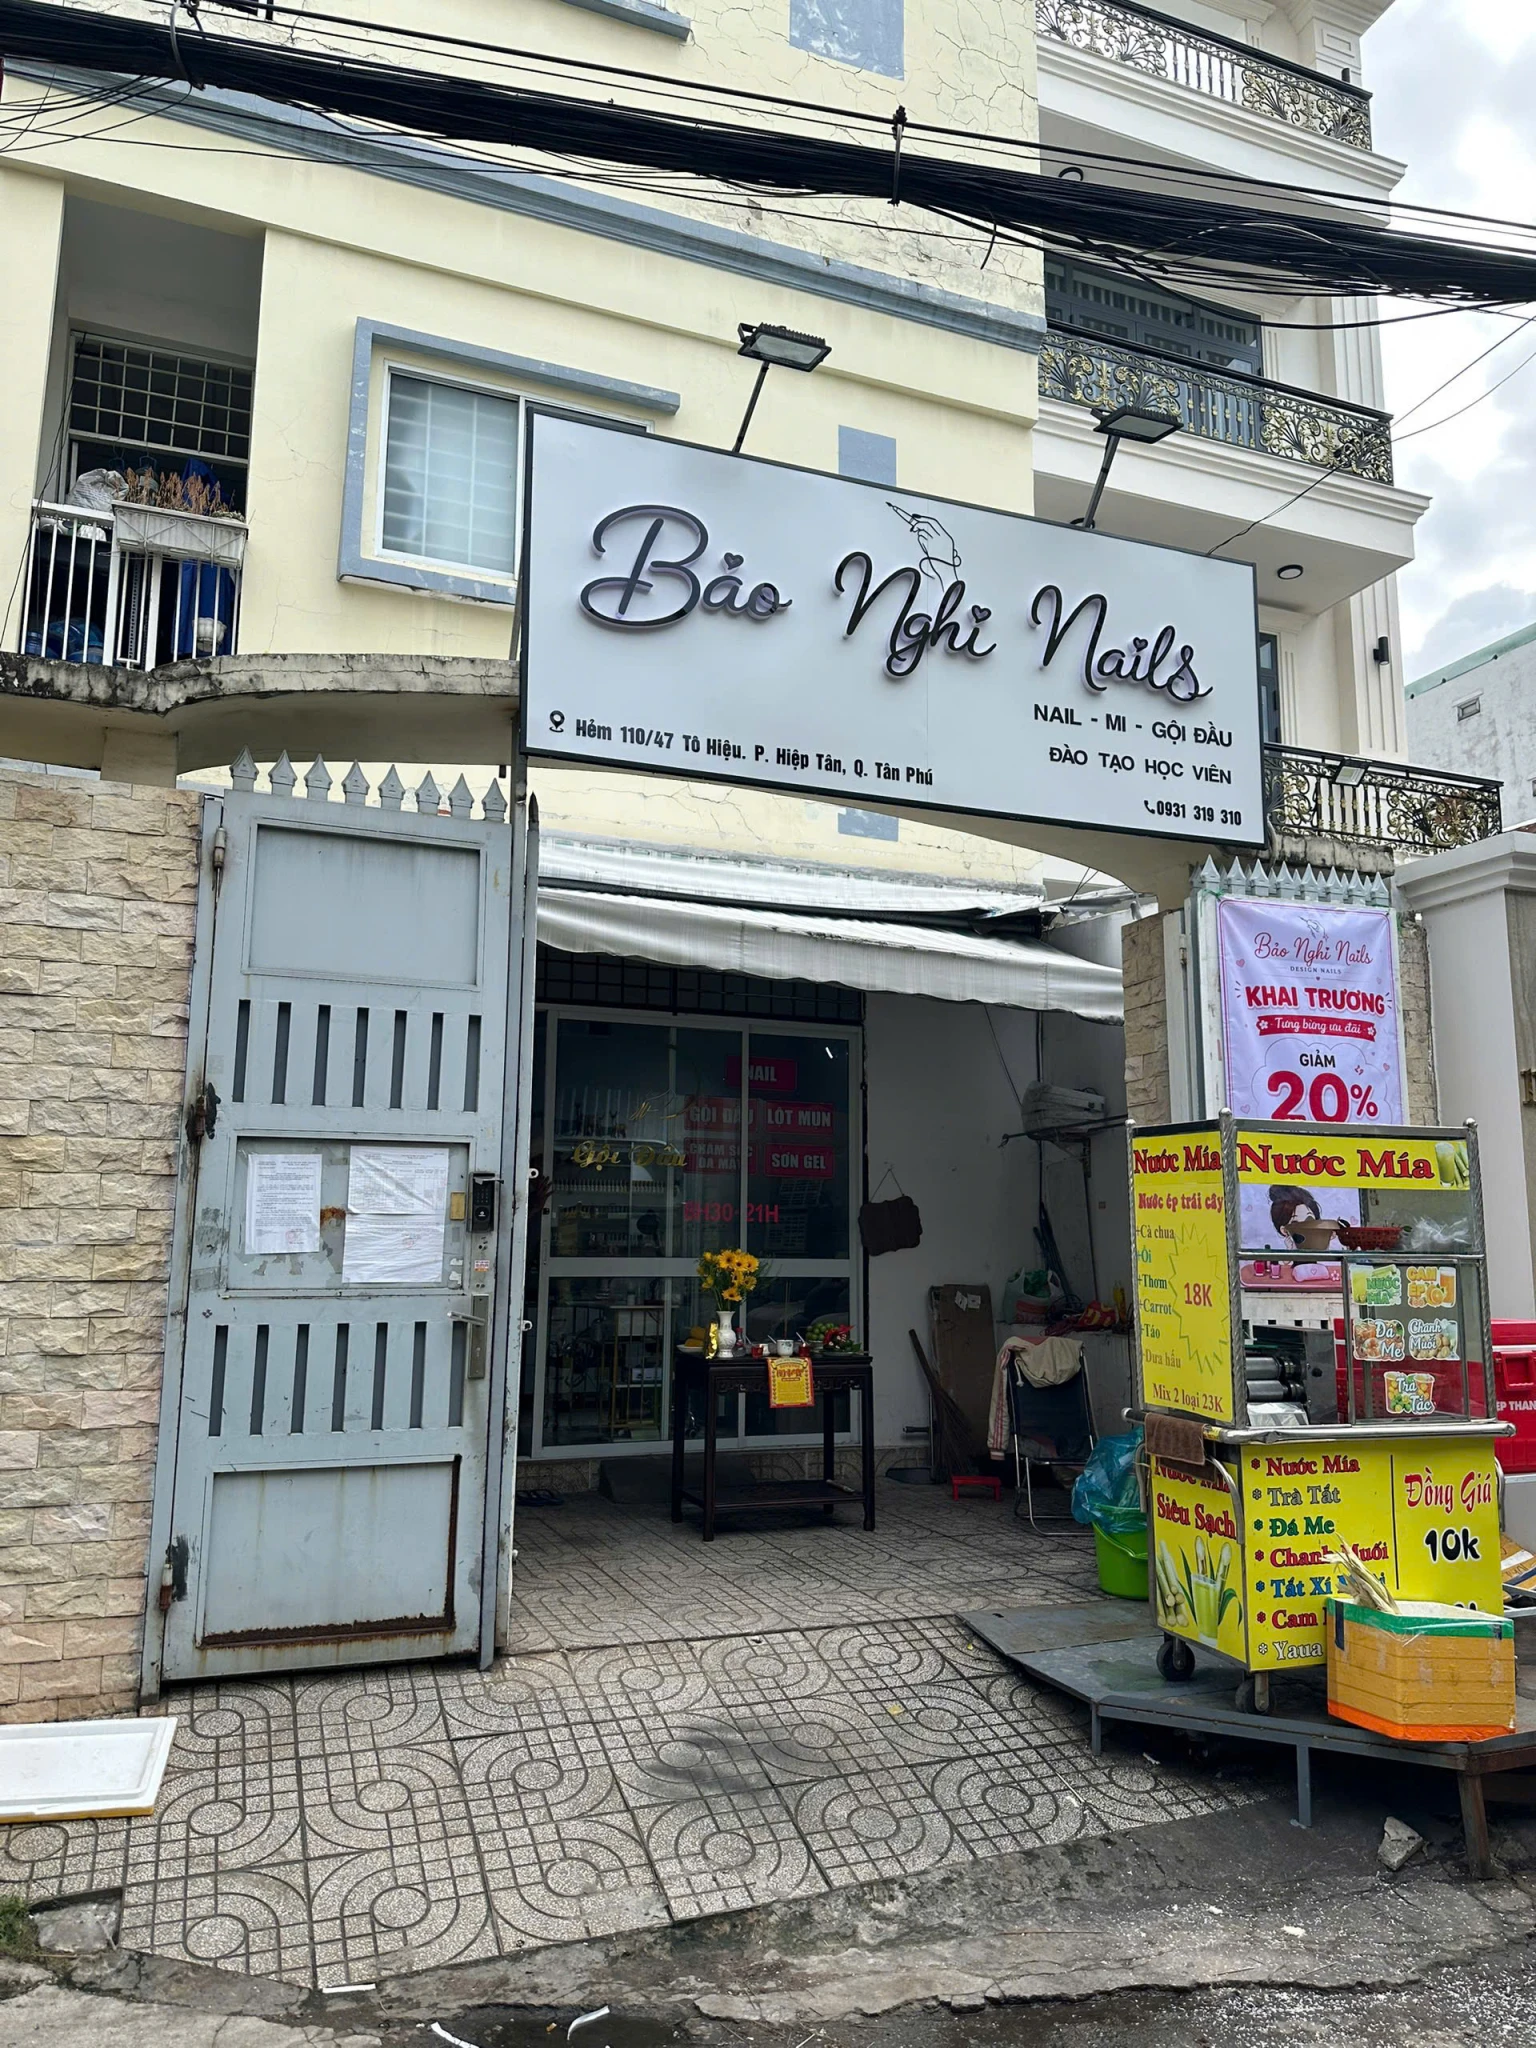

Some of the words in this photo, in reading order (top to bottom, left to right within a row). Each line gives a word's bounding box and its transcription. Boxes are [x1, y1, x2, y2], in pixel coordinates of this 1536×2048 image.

[578, 504, 793, 629] Bảo
[834, 551, 997, 679] Nghi
[1030, 584, 1214, 703] Nails
[1033, 703, 1082, 726] NAIL
[1105, 713, 1127, 733] MI
[1152, 719, 1186, 745] GỘI
[1193, 721, 1233, 747] ĐẦU
[576, 719, 612, 741] Hẻm
[620, 726, 674, 749] 110/47
[682, 734, 701, 753] Tô
[754, 745, 769, 763] P.
[776, 747, 809, 770] Hiệp
[816, 753, 846, 775] Tân,
[854, 759, 868, 777] Q.
[874, 762, 900, 781] Tân
[906, 766, 933, 786] Phú
[1049, 743, 1088, 766] ĐÀO
[1098, 752, 1135, 773] TẠO
[1145, 758, 1184, 780] HỌC
[1192, 764, 1232, 784] VIÊN
[1156, 800, 1186, 819] 0931
[1193, 805, 1215, 822] 319
[1220, 809, 1242, 826] 310
[1254, 932, 1290, 959] Bảo
[1293, 936, 1332, 967] Nghi
[1335, 940, 1374, 966] Nails
[1245, 985, 1299, 1008] KHAI
[1304, 987, 1385, 1015] TRƯƠNG
[1275, 1018, 1300, 1033] Tưng
[1302, 1018, 1326, 1034] bừng
[1329, 1023, 1341, 1032] ưu
[1344, 1022, 1362, 1034] đãi
[1299, 1049, 1336, 1068] GIẢM
[1267, 1070, 1379, 1123] 20%
[767, 1105, 793, 1127] LỘT
[798, 1110, 831, 1129] MỤN
[771, 1151, 799, 1169] SƠN
[804, 1154, 827, 1170] GEL
[1133, 1148, 1180, 1174] Nước
[1183, 1145, 1223, 1172] Mía
[1237, 1142, 1346, 1177] Nước
[1357, 1149, 1435, 1180] Mía
[1138, 1193, 1164, 1209] Nước
[1166, 1193, 1178, 1212] ép
[1181, 1193, 1202, 1210] trái
[1205, 1193, 1224, 1213] cây
[1154, 1225, 1174, 1239] chua
[1407, 1267, 1437, 1281] CAM
[1184, 1282, 1212, 1307] 18K
[1374, 1321, 1395, 1338] Đá
[1409, 1319, 1442, 1334] Chanh
[1382, 1342, 1403, 1358] Me
[1410, 1334, 1437, 1350] Muối
[1165, 1349, 1181, 1369] hấu
[1152, 1383, 1171, 1401] Mix
[1174, 1388, 1180, 1403] 2
[1181, 1389, 1200, 1410] loại
[1202, 1394, 1224, 1413] 23K
[1265, 1457, 1318, 1477] Nước
[1322, 1454, 1361, 1474] Mía
[1266, 1487, 1303, 1507] Trà
[1404, 1466, 1454, 1514] Đồng
[1460, 1471, 1492, 1513] Giá
[1157, 1492, 1191, 1526] Siêu
[1194, 1503, 1237, 1540] Sạch
[1269, 1518, 1299, 1537] Đá
[1303, 1515, 1335, 1535] Me
[1424, 1528, 1480, 1562] 10k
[1309, 1575, 1333, 1596] Xí
[1271, 1609, 1318, 1630] Cam
[1273, 1641, 1322, 1660] Yaua
